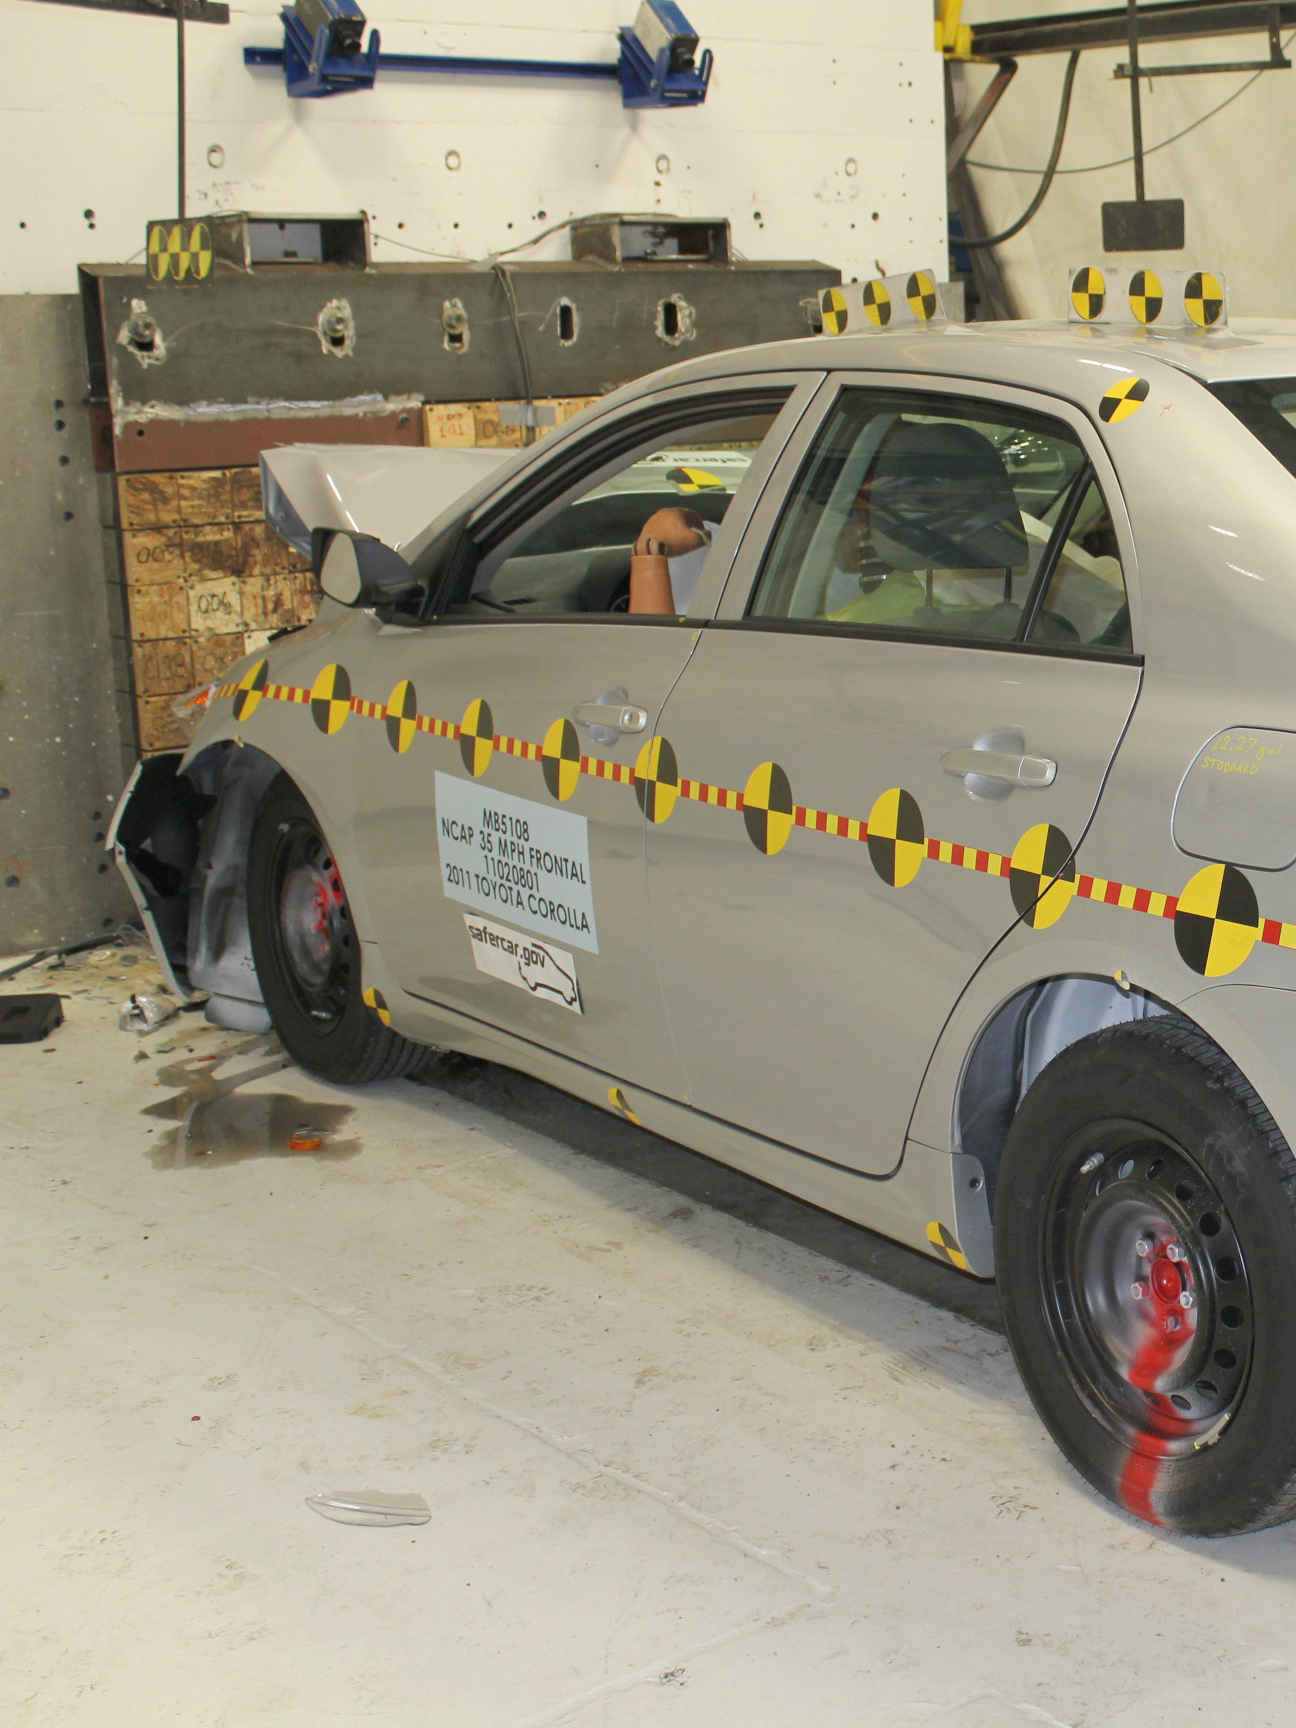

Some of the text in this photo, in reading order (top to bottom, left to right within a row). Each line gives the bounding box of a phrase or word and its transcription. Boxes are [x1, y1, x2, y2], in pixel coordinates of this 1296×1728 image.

[1212, 735, 1258, 753] 12.27
[1201, 756, 1258, 775] STODDARD
[482, 807, 530, 842] MB5108
[441, 816, 587, 885] NCAP 35 MPH FRONTAL
[484, 854, 540, 893] 11020801
[445, 862, 591, 934] 2011 TOYOTA COROLLA
[468, 923, 545, 968] safercar.gov
